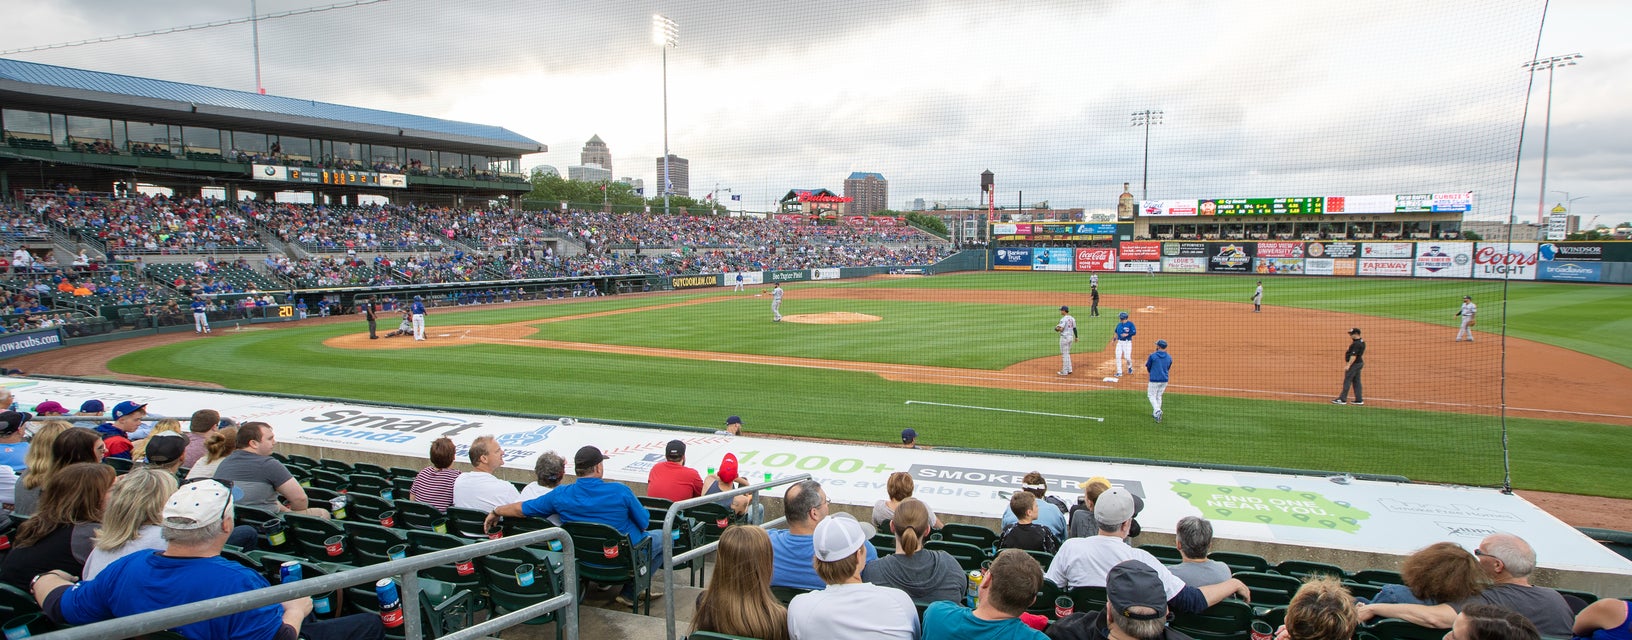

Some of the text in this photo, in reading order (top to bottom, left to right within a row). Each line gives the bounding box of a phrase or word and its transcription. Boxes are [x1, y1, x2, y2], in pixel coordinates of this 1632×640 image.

[1079, 250, 1108, 260] Coca-Cola
[1475, 246, 1537, 266] Coors
[1560, 246, 1602, 254] WINDSOR
[1485, 265, 1526, 274] LIGHT
[1547, 265, 1593, 274] broadlawns
[279, 306, 293, 317] 20
[301, 410, 483, 436] Smart
[300, 424, 417, 443] Honda
[1211, 493, 1320, 508] FIND ONE
[1206, 500, 1336, 517] NEAR YOU.
